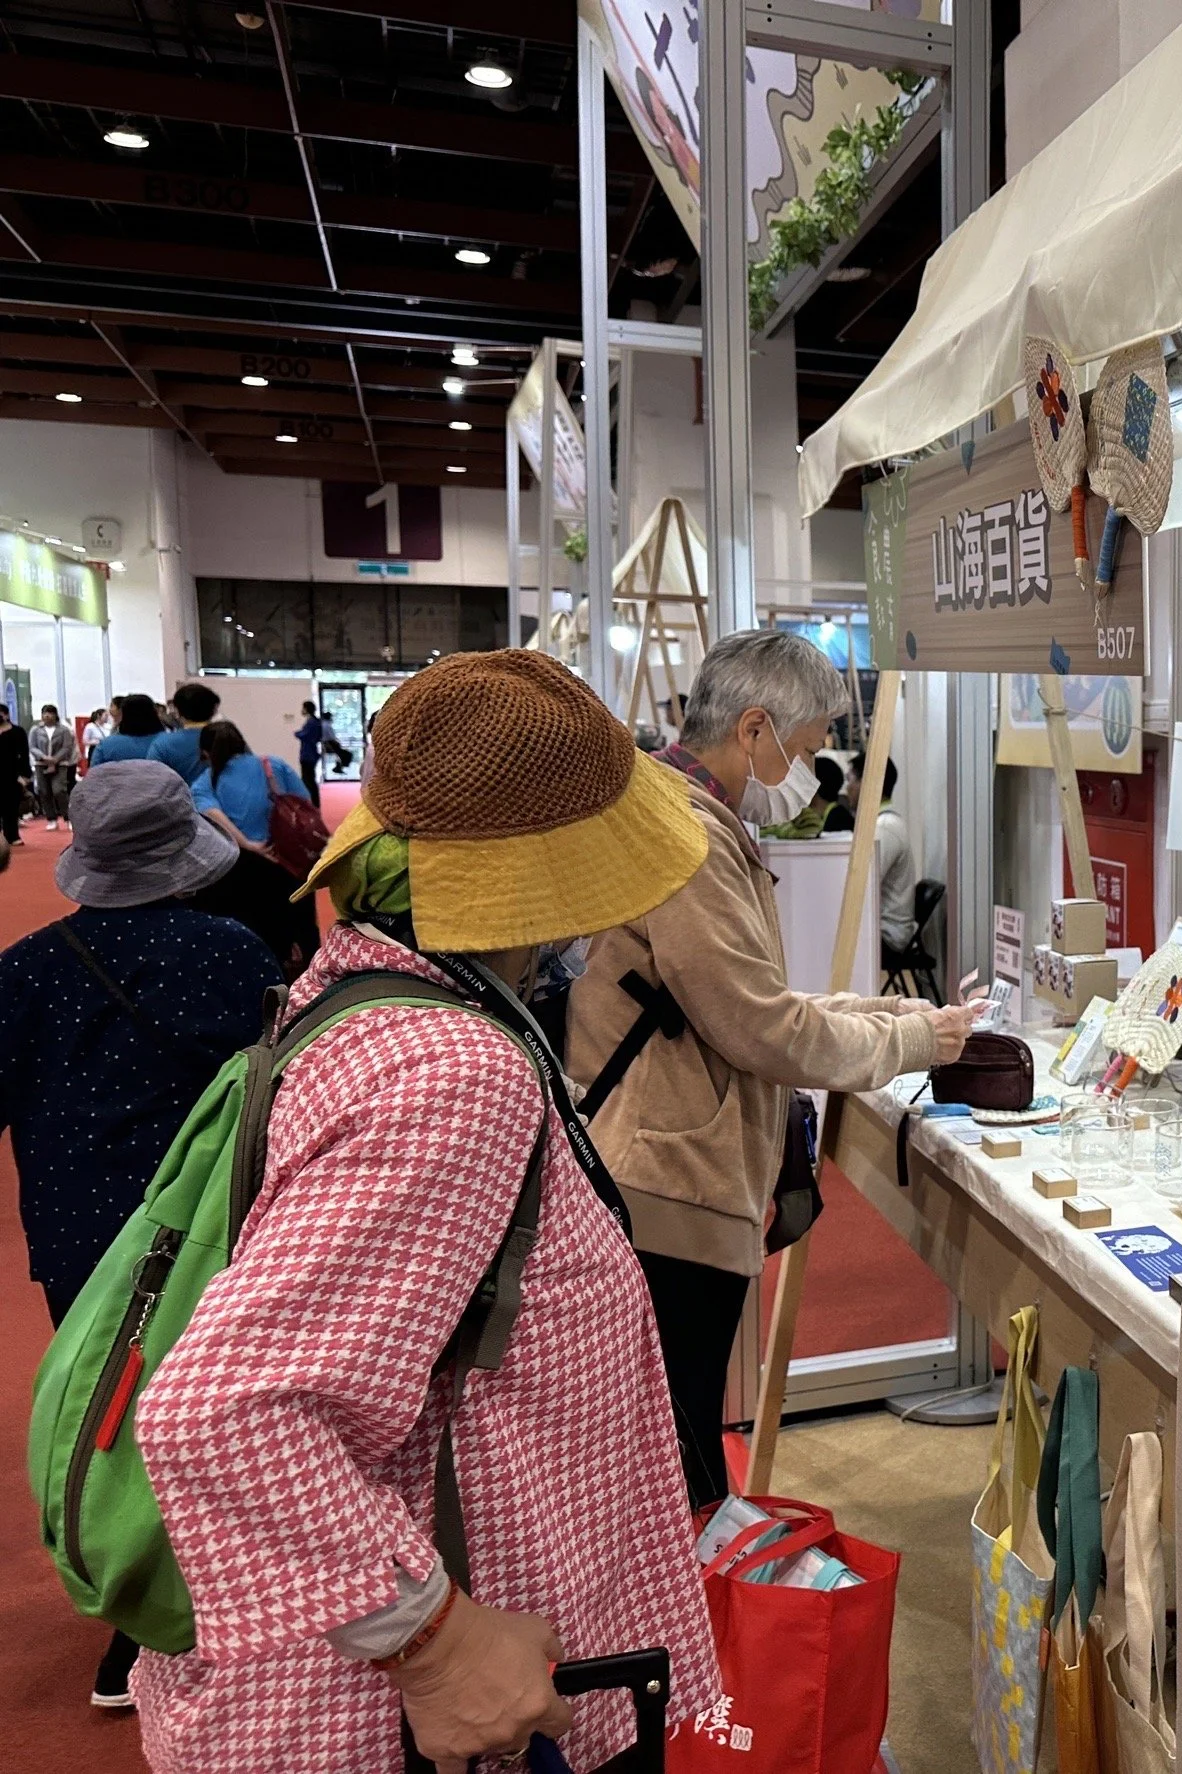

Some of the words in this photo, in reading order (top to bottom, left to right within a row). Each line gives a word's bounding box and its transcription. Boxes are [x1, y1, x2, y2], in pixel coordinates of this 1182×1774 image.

[143, 173, 251, 211] B300
[240, 353, 312, 379] B200
[279, 420, 334, 440] B100
[365, 481, 402, 555] 1
[932, 489, 1050, 604] 山海百貨
[1097, 626, 1135, 660] B507
[437, 952, 487, 992] GARMIN
[523, 1031, 553, 1082] GARMIN
[567, 1122, 596, 1169] GARMIN
